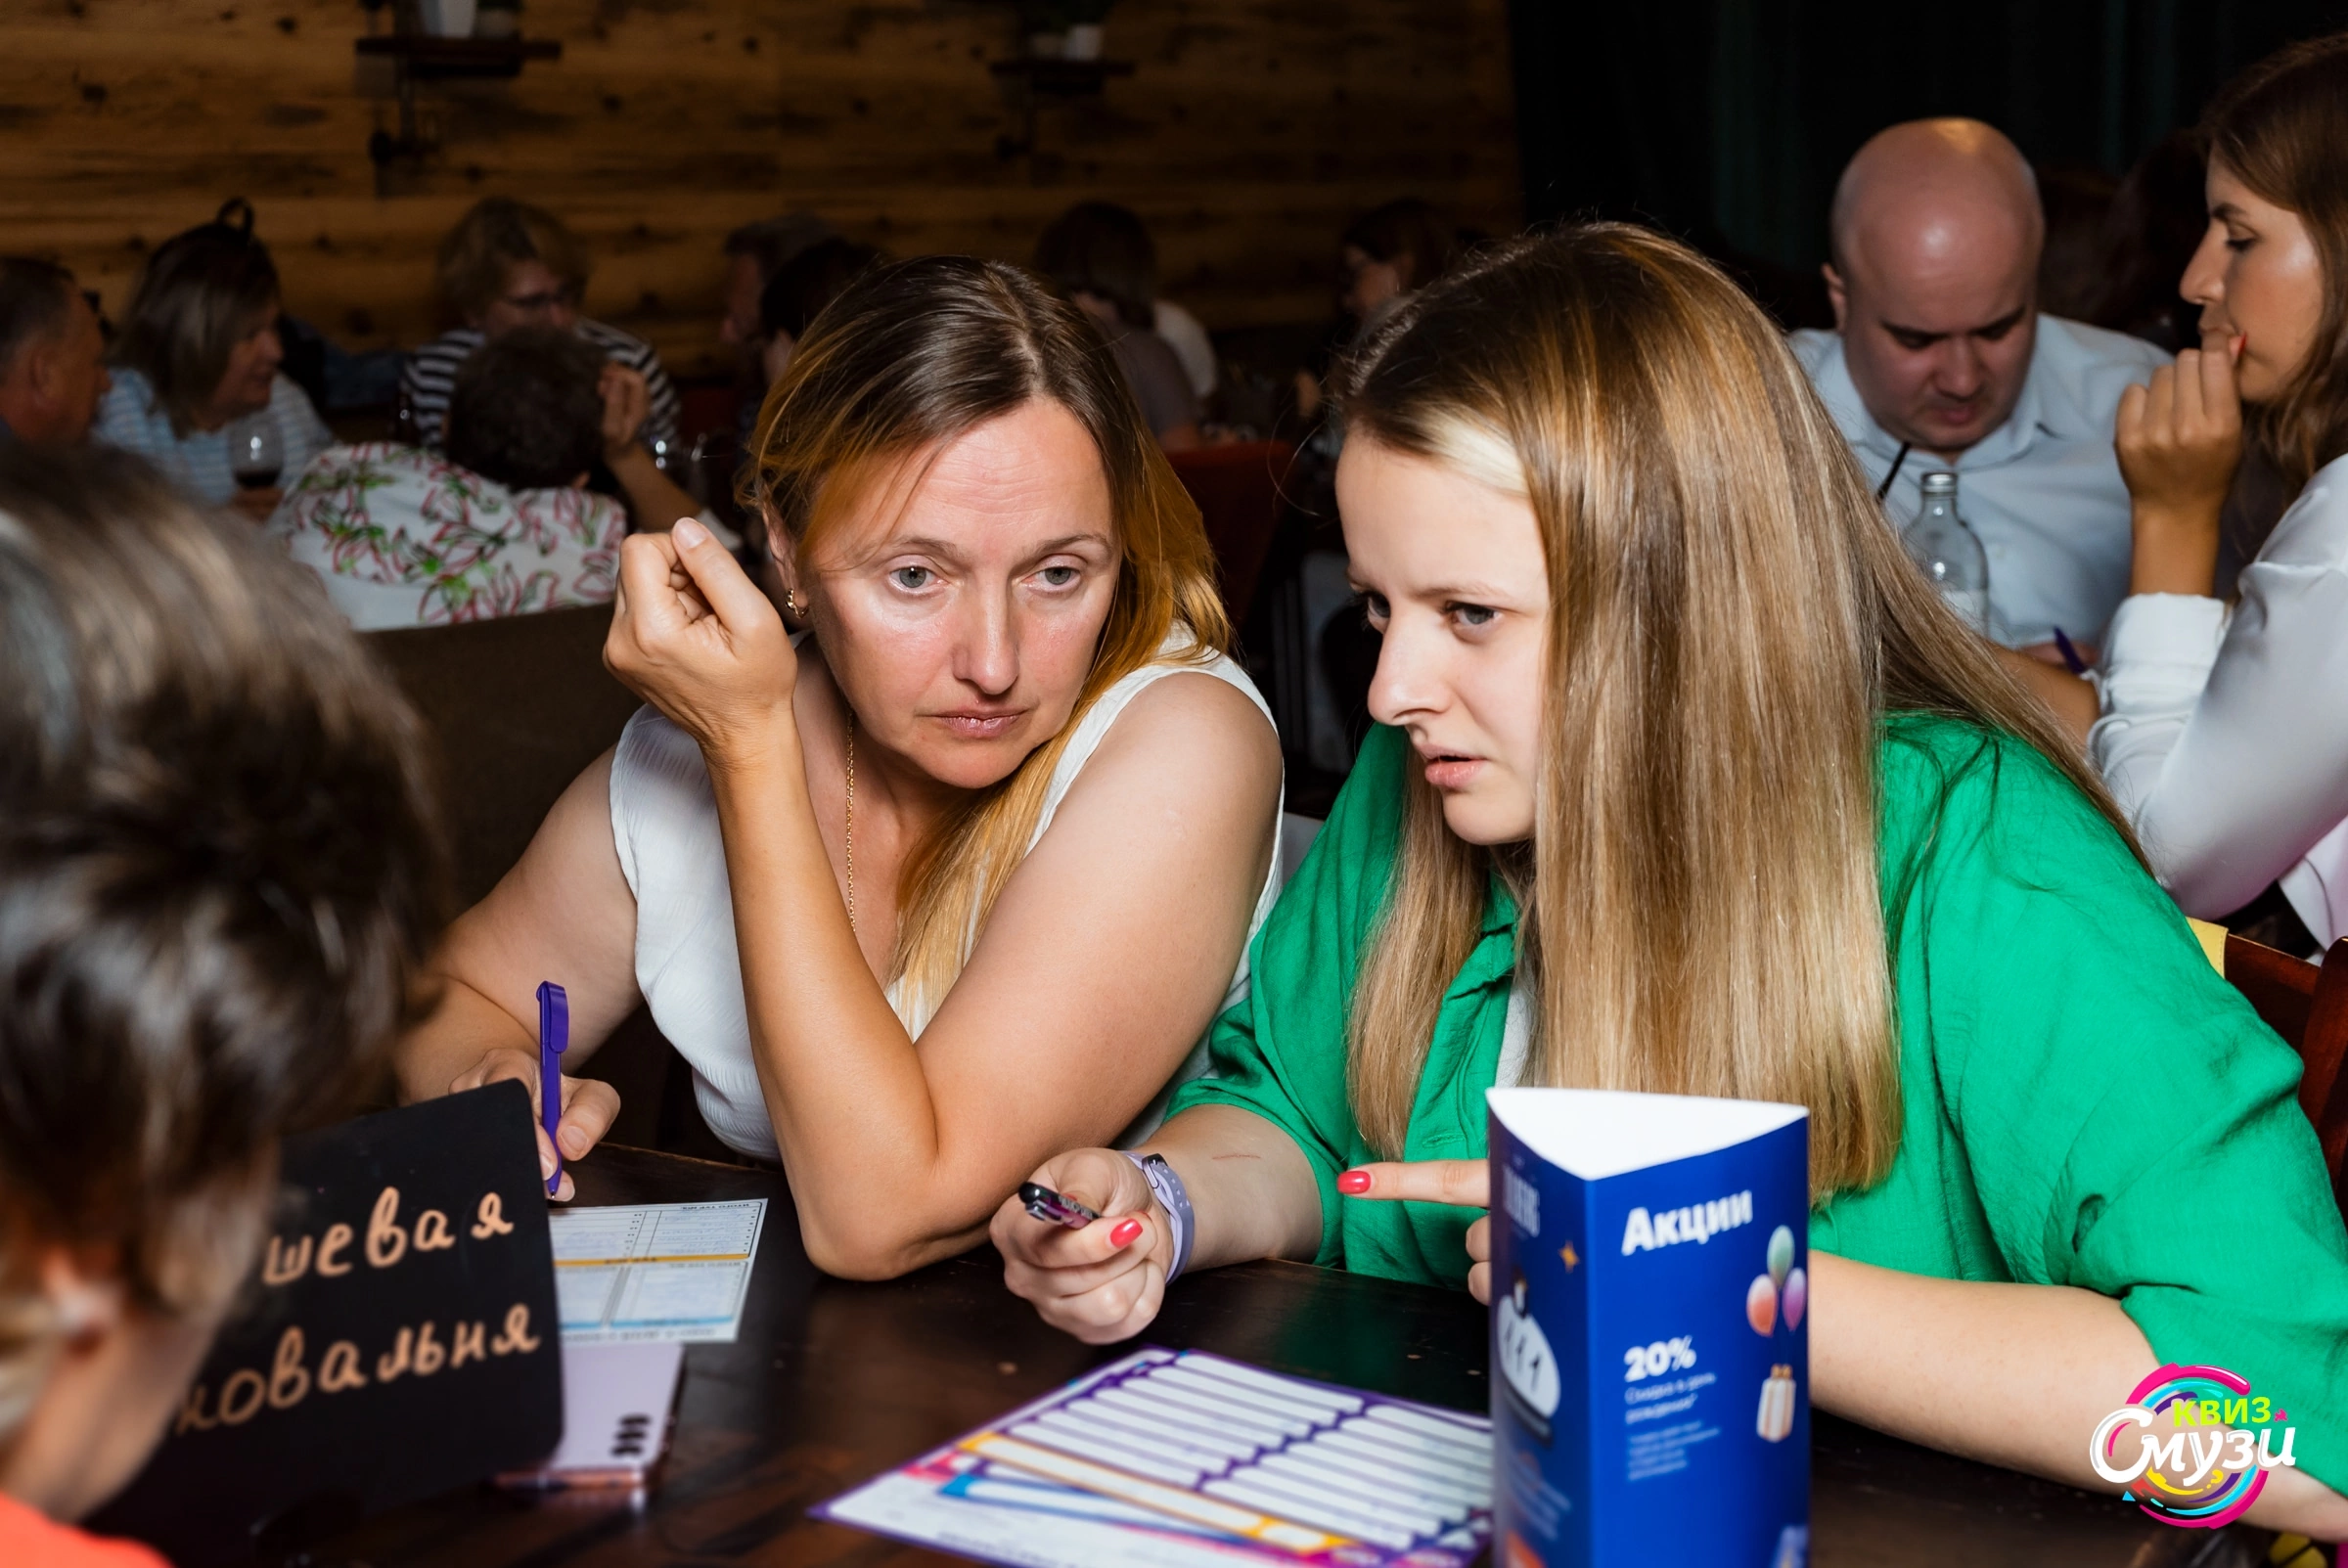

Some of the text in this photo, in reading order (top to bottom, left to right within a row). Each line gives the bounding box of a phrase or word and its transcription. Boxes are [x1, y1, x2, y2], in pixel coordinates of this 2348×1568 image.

[262, 1187, 515, 1286] шевая
[1621, 1189, 1753, 1257] Акции
[1624, 1335, 1696, 1383] 20%
